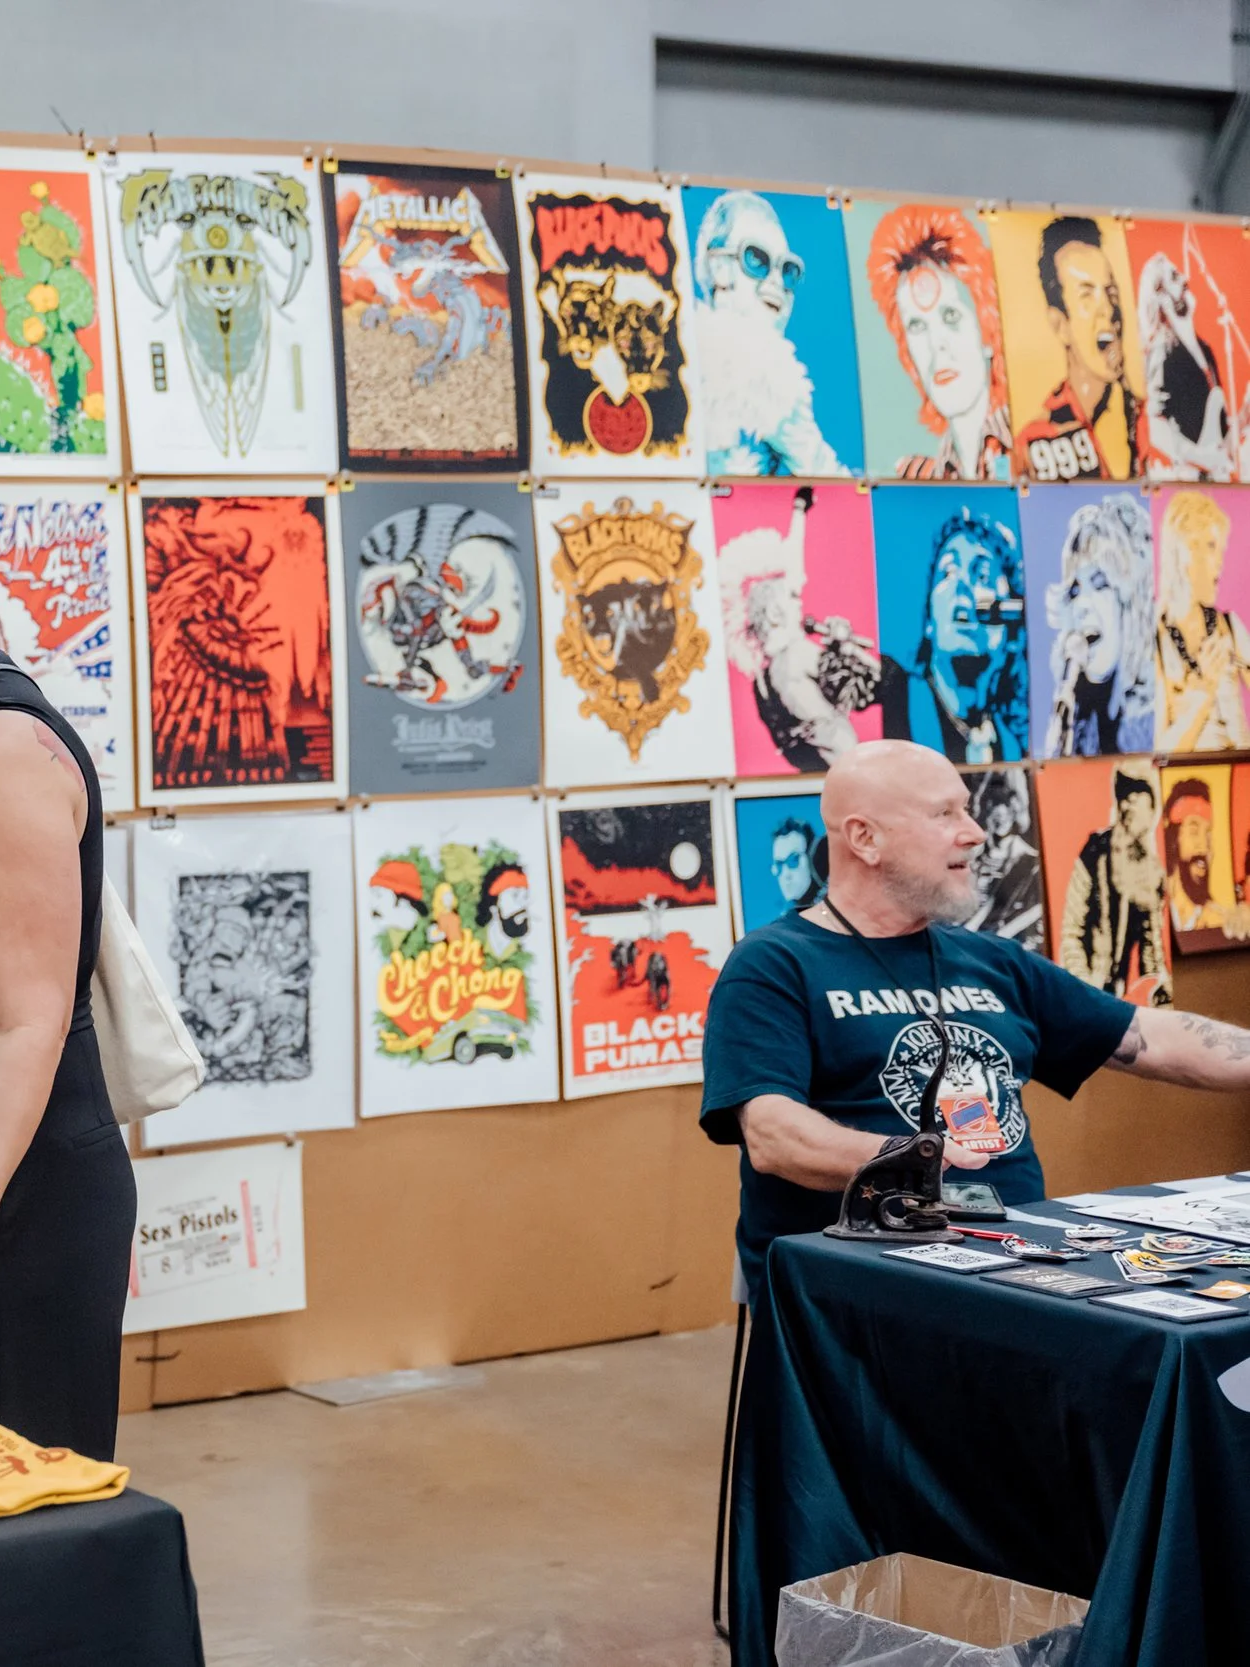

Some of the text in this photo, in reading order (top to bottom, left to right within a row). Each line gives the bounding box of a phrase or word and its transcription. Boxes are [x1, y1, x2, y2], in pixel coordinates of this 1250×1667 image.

[1030, 428, 1099, 480] 999
[377, 928, 486, 1018] Cheech
[428, 965, 524, 1022] Chong
[825, 985, 1006, 1019] RAMONES
[583, 1011, 703, 1048] BLACK
[584, 1037, 703, 1073] PUMAS
[960, 1137, 1001, 1150] ARTIST
[139, 1223, 172, 1245] Sex
[179, 1205, 238, 1236] Pistols
